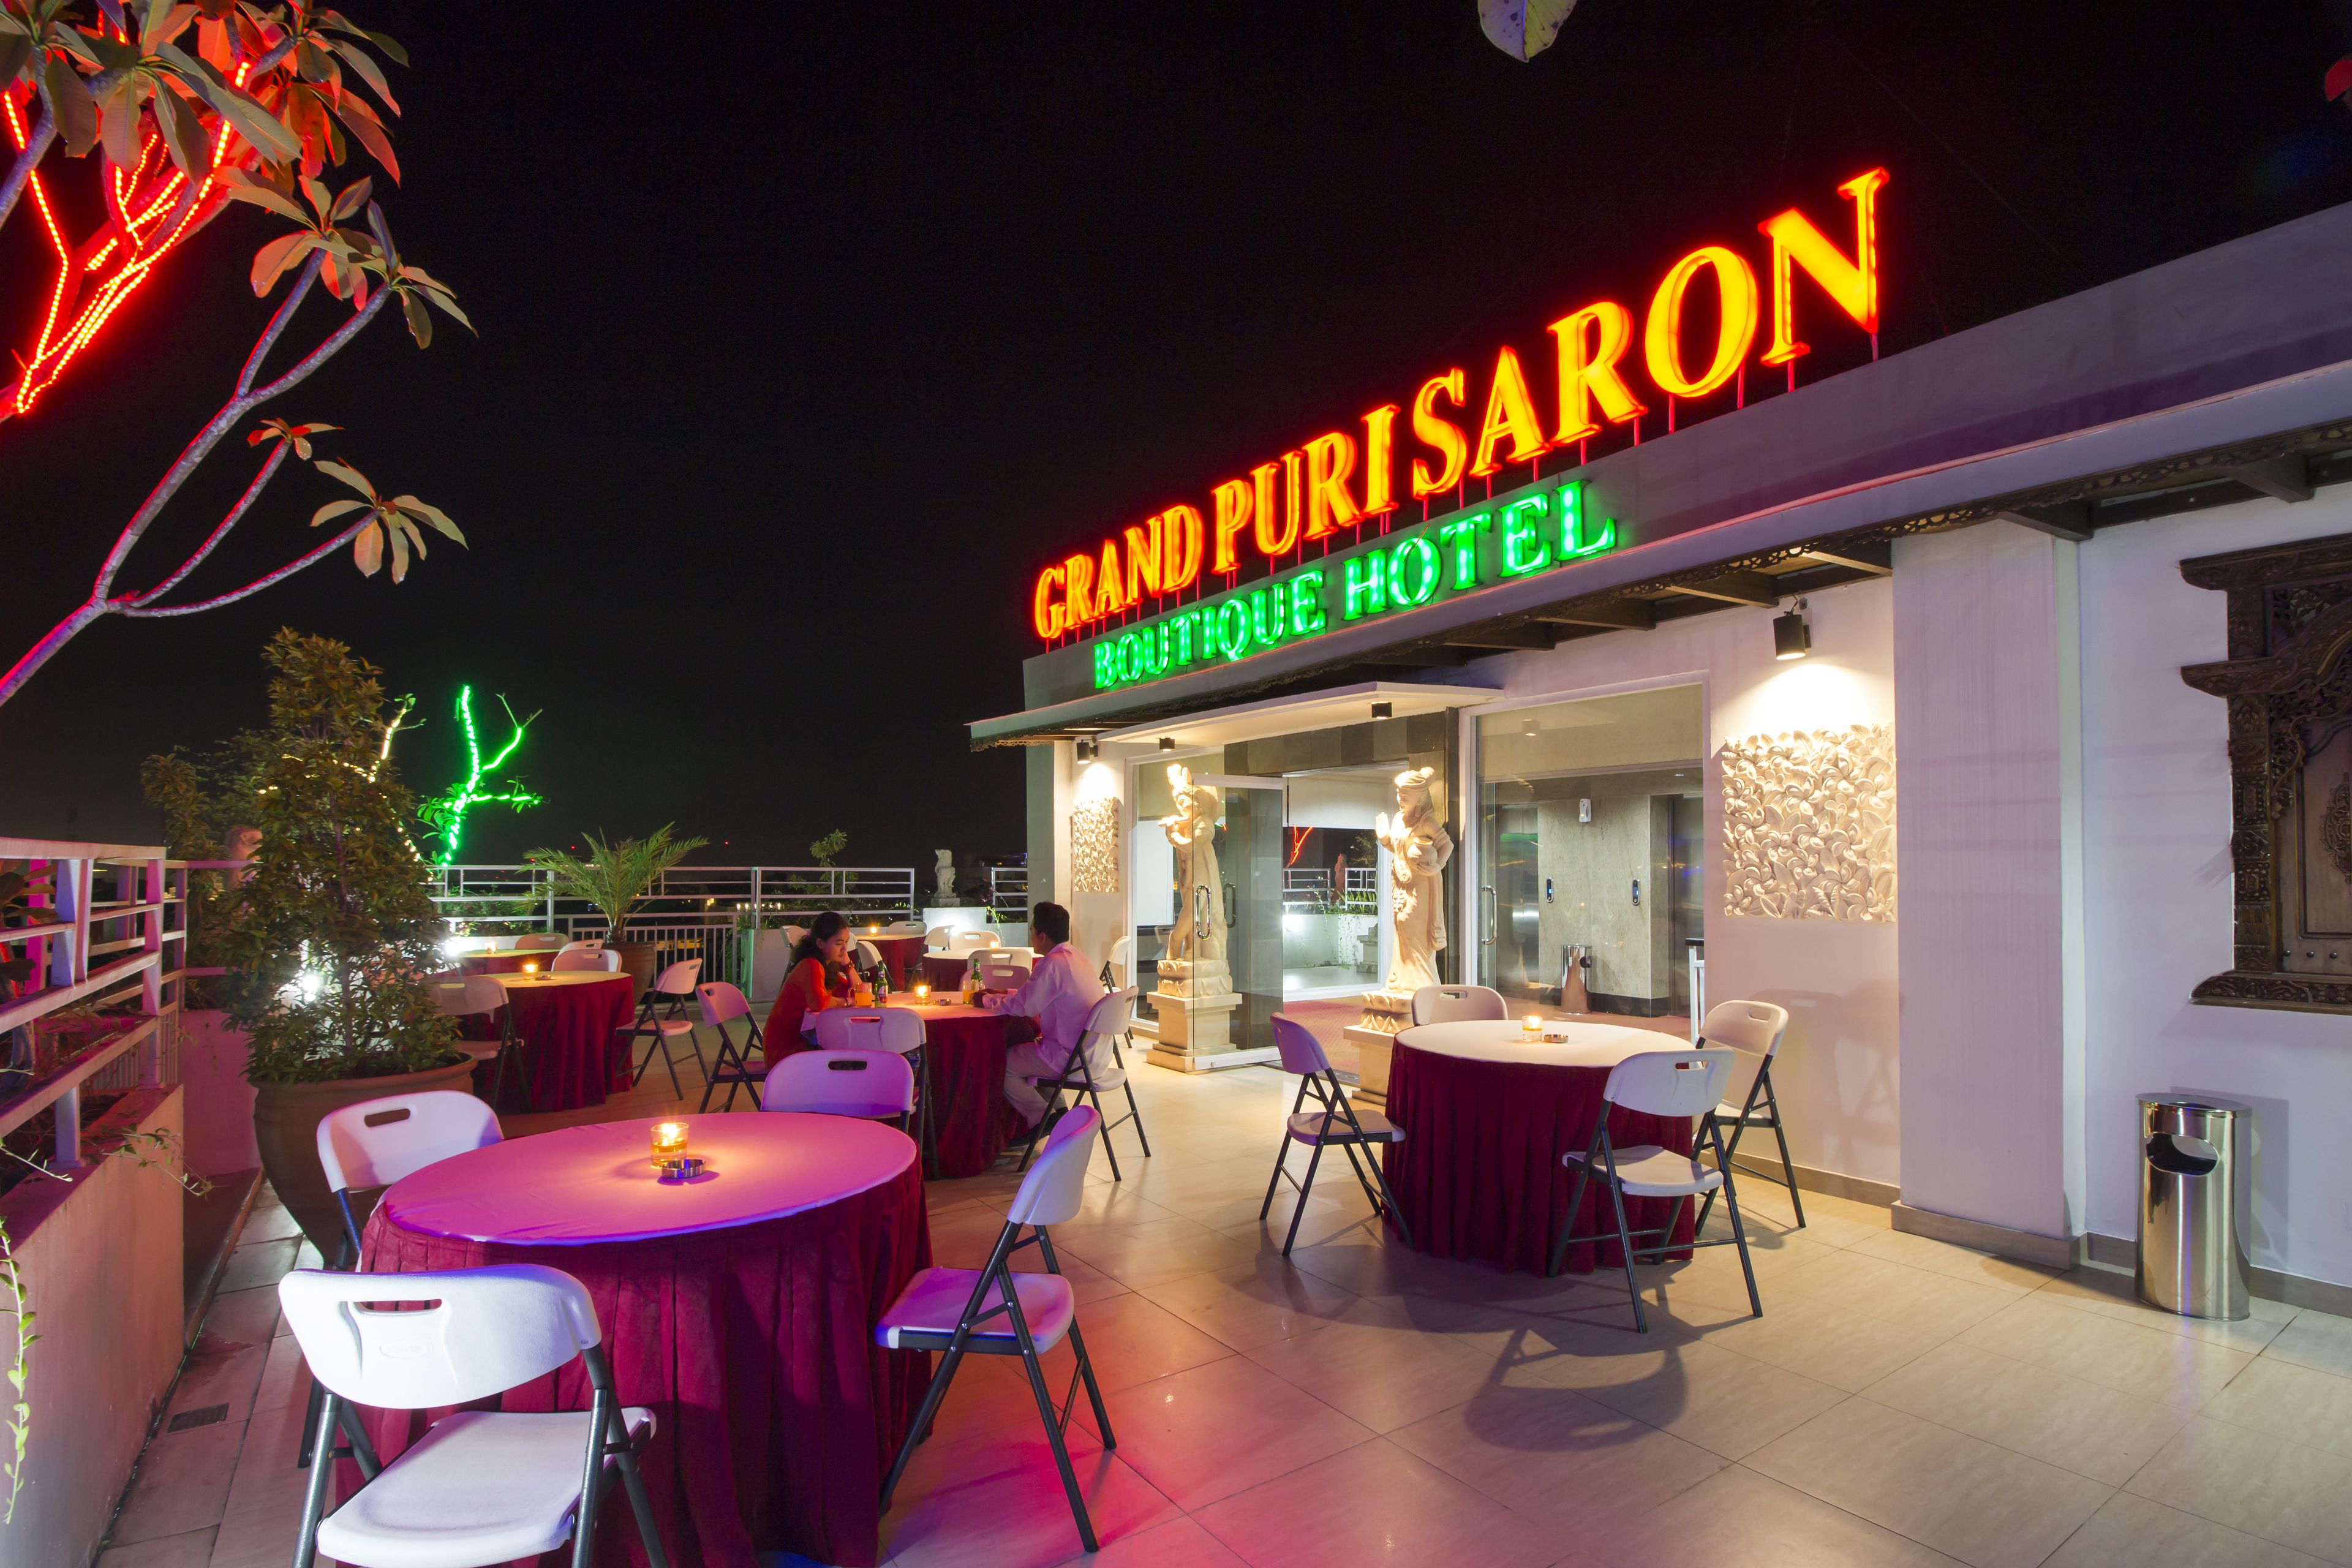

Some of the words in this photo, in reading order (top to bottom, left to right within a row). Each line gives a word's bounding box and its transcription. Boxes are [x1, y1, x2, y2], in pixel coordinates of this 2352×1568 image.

[1035, 504, 1204, 639] GRAND
[1212, 404, 1400, 573] PURI
[1412, 167, 1889, 499] SARON
[1093, 569, 1326, 689] BOUTIQUE
[1343, 480, 1616, 621] HOTEL
